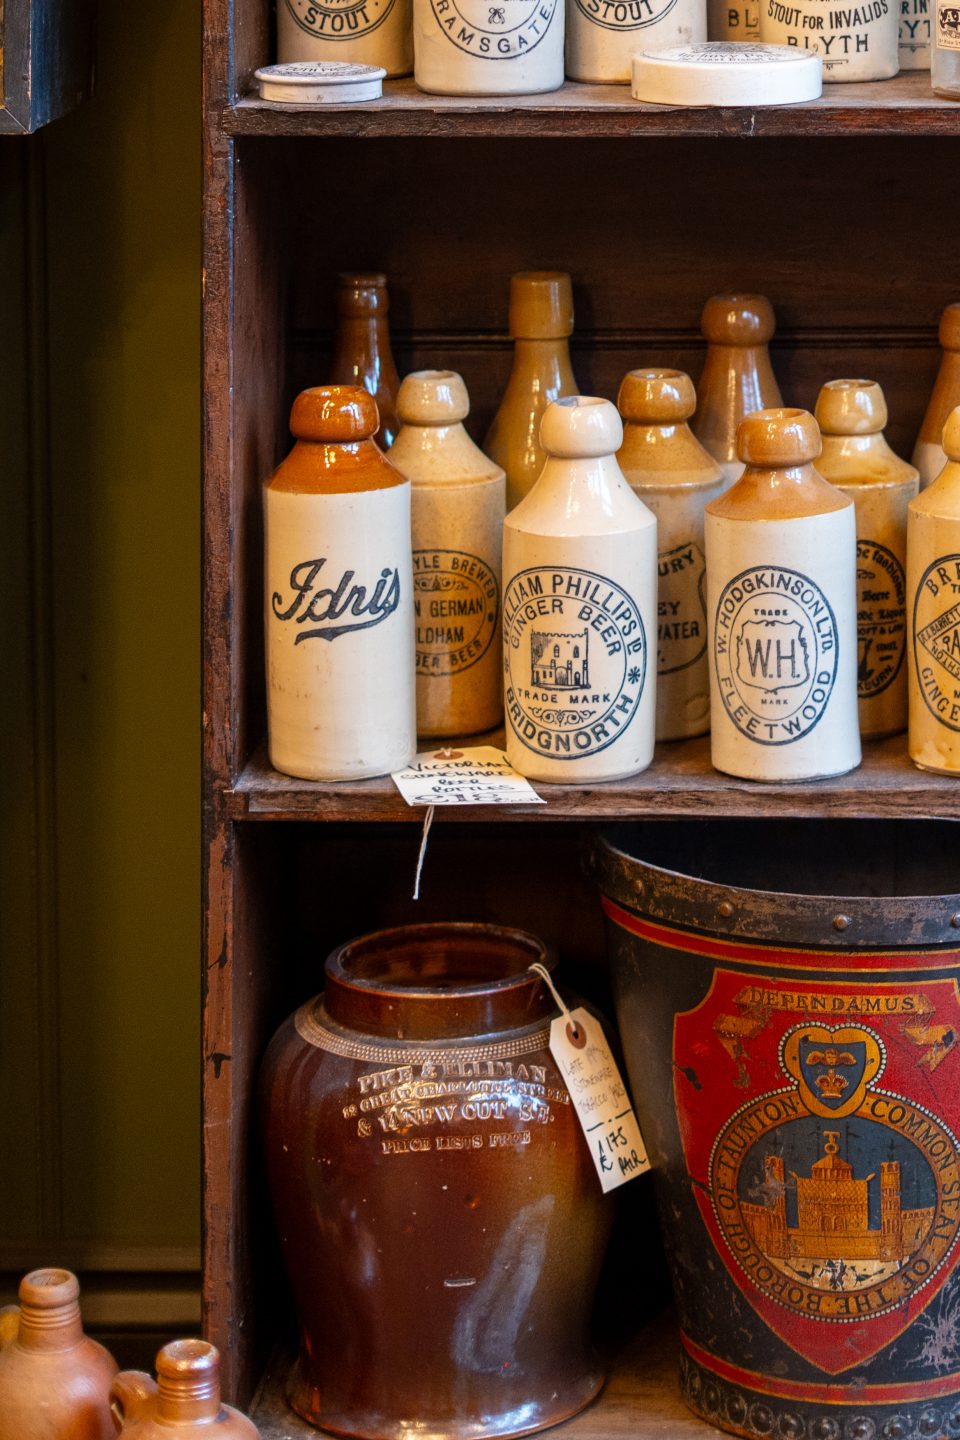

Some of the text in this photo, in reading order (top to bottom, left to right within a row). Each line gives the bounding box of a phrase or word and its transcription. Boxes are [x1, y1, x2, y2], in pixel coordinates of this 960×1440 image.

[304, 5, 370, 32] STOUT
[767, 0, 801, 28] STOUT
[802, 14, 824, 30] FOR
[272, 558, 401, 624] Idris
[451, 557, 496, 599] BREWED
[431, 597, 483, 618] GERMAN
[552, 574, 637, 637] PHILLIPS
[720, 573, 824, 629] HODGKINSON
[754, 609, 788, 617] TRADE
[510, 599, 622, 657] GINGER BEER
[451, 639, 483, 666] BEER
[517, 687, 610, 704] TRADE MARK
[721, 670, 831, 739] FLEETWOOD
[506, 687, 633, 752] BRIDGNORTH
[749, 988, 916, 1012] DEFENDAMUS
[357, 1066, 414, 1094] PIKE
[442, 1061, 547, 1083] ELLIMAN
[460, 1102, 508, 1121] CUT
[599, 1127, 628, 1173] £175
[716, 1098, 960, 1317] COMMON SEAL OF THE BOROUGH OF TAUNTON
